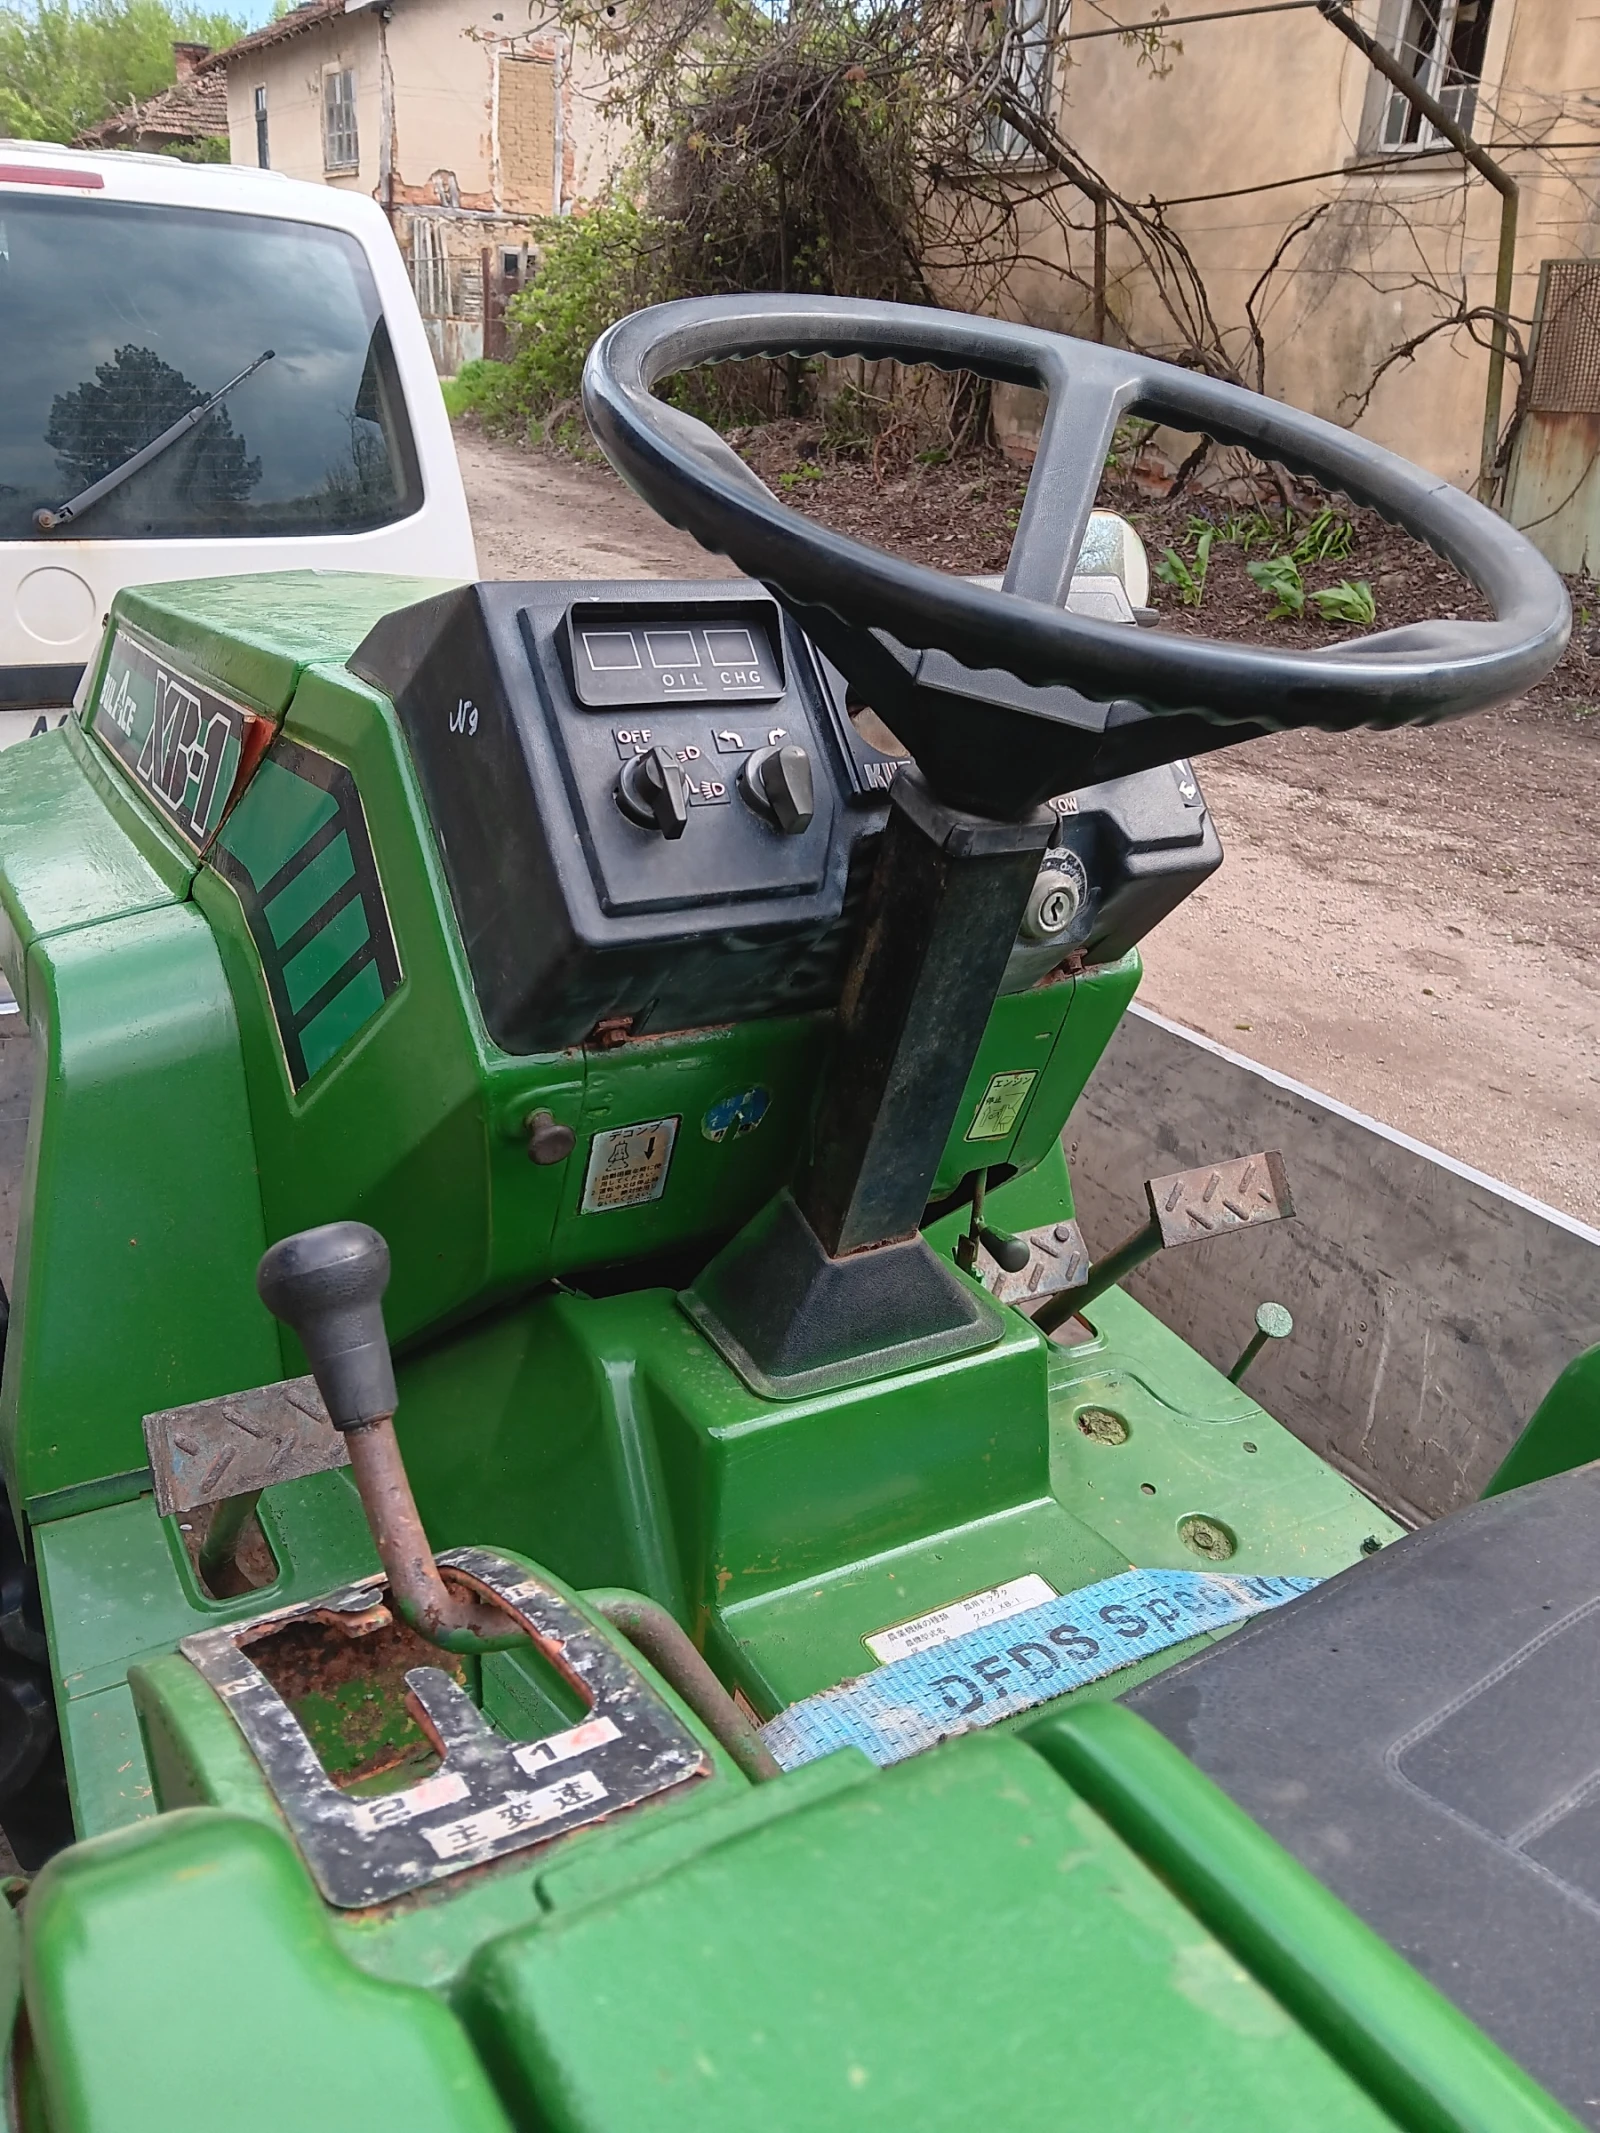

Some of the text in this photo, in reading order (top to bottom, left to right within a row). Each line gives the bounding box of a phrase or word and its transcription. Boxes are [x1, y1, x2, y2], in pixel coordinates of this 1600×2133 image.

[662, 673, 704, 687] OIL
[720, 671, 761, 684] CHG
[617, 730, 651, 743] OFF
[136, 668, 231, 838] XB-1
[993, 1076, 1032, 1088] エンジン
[609, 1121, 663, 1141] デコンプ
[887, 1612, 950, 1642] 農業機械の種類
[927, 1624, 1099, 1715] DFDS
[446, 1781, 594, 1850] 主変速
